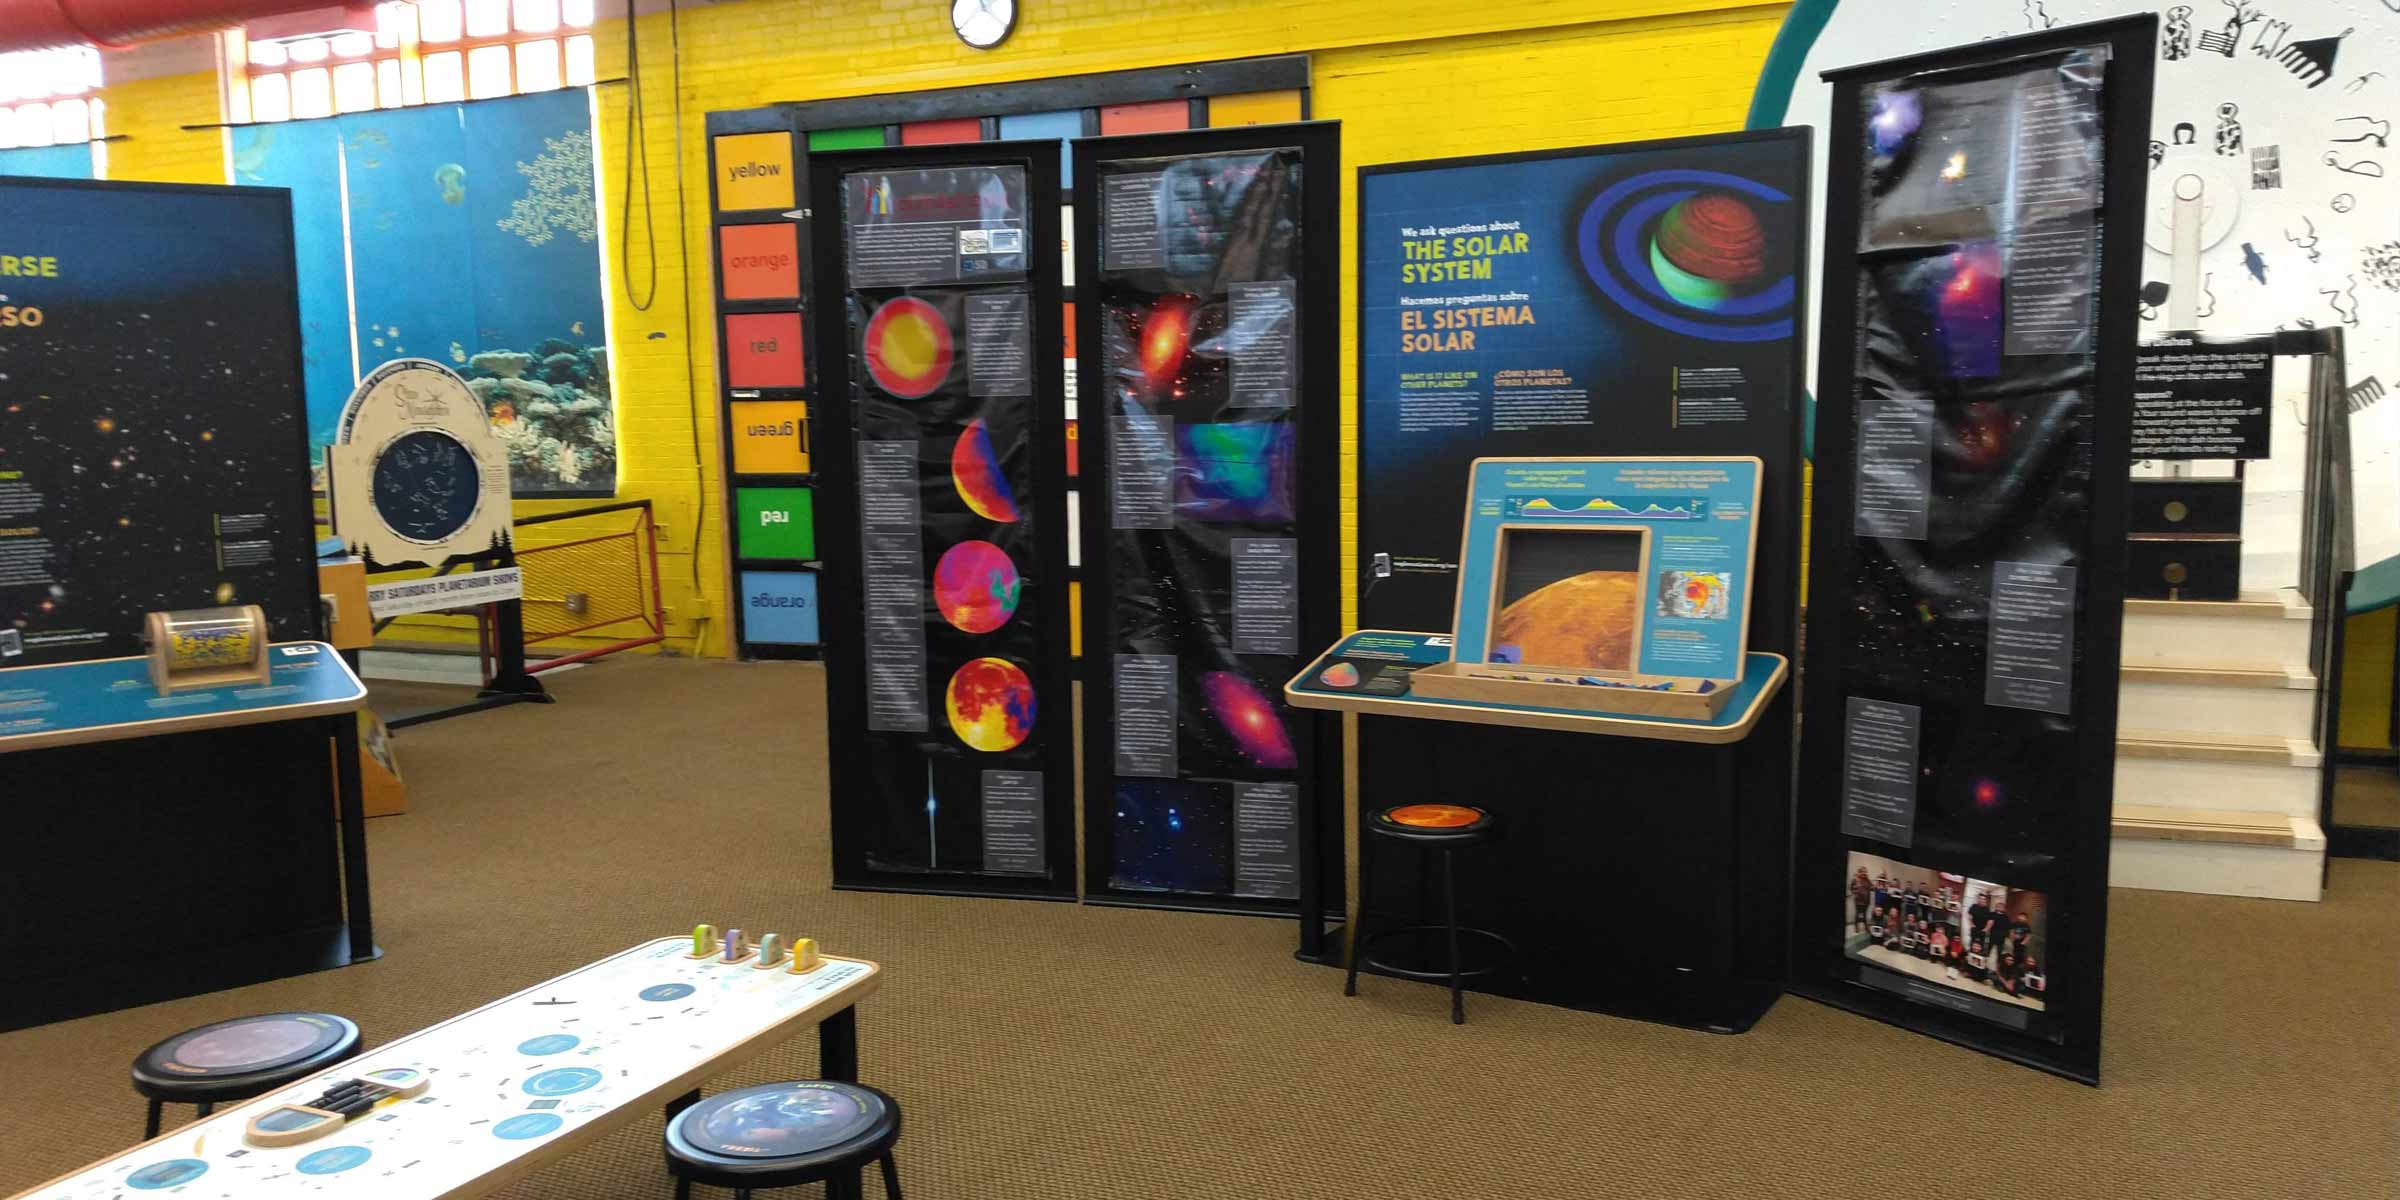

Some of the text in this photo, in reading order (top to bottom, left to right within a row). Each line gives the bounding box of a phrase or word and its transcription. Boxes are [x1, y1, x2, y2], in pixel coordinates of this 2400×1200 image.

[728, 162, 781, 182] yellow
[1401, 221, 1520, 237] We ask questions about
[1402, 232, 1529, 259] THE SOLAR
[731, 253, 790, 272] orange
[1402, 258, 1492, 283] SYSTEM
[1400, 291, 1528, 305] Hacemos preguntas sobre
[1401, 305, 1536, 331] EL SISTEMA
[751, 338, 777, 353] red
[1401, 330, 1476, 353] SOLAR
[746, 420, 794, 437] green
[760, 510, 790, 527] red
[388, 583, 437, 600] SATURDAYS
[438, 575, 491, 593] PLANETARIUM
[493, 572, 519, 585] SHOWS
[751, 592, 807, 609] orange
